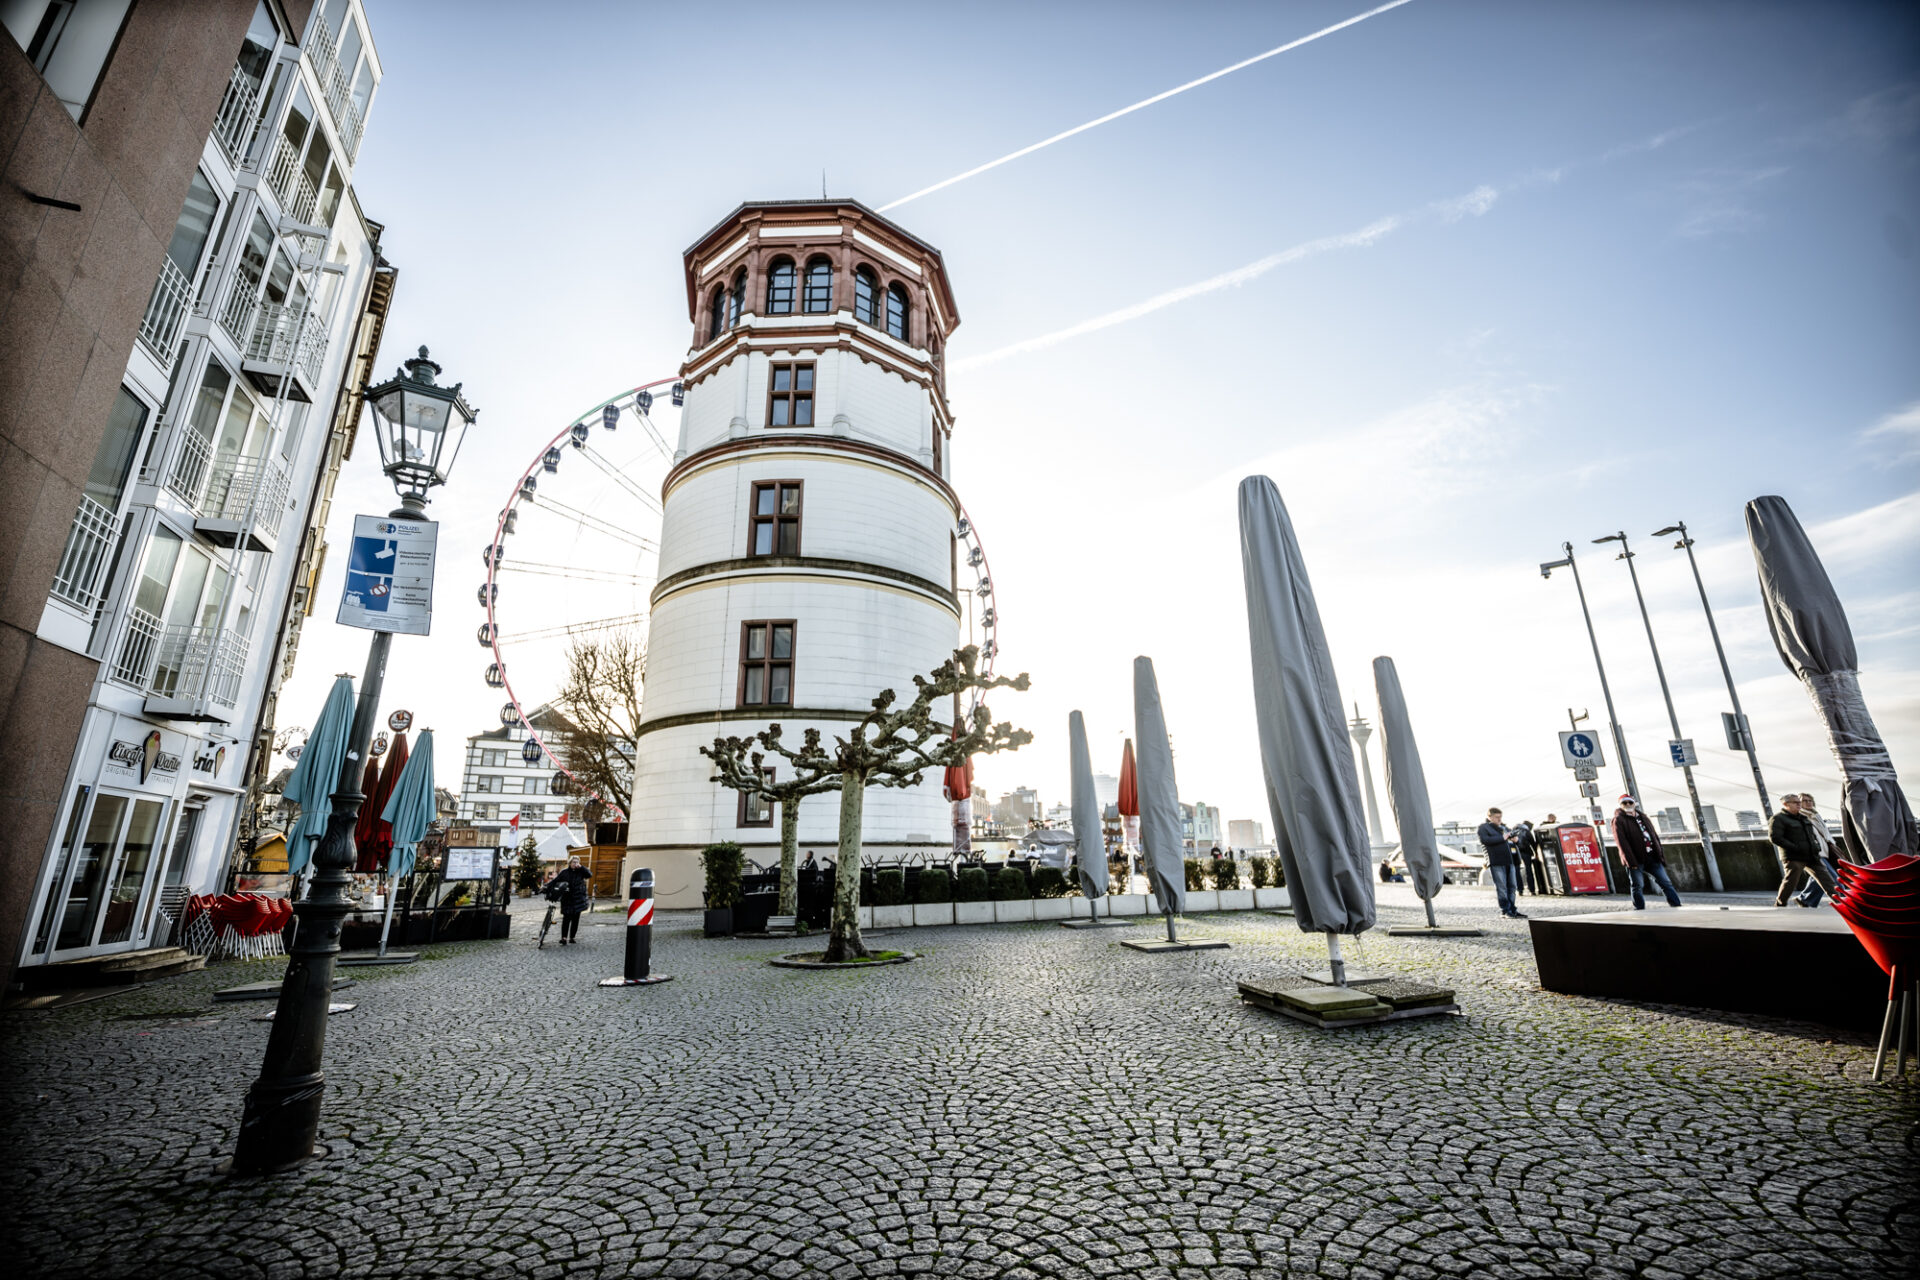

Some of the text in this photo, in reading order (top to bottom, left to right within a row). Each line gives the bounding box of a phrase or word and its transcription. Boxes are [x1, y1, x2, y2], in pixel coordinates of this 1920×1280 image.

[154, 753, 181, 773] Dante
[1574, 759, 1594, 767] ZONE
[105, 766, 137, 777] ORIGINALE
[1575, 844, 1590, 852] Ich
[1563, 851, 1592, 859] mache
[1583, 857, 1603, 865] Rest
